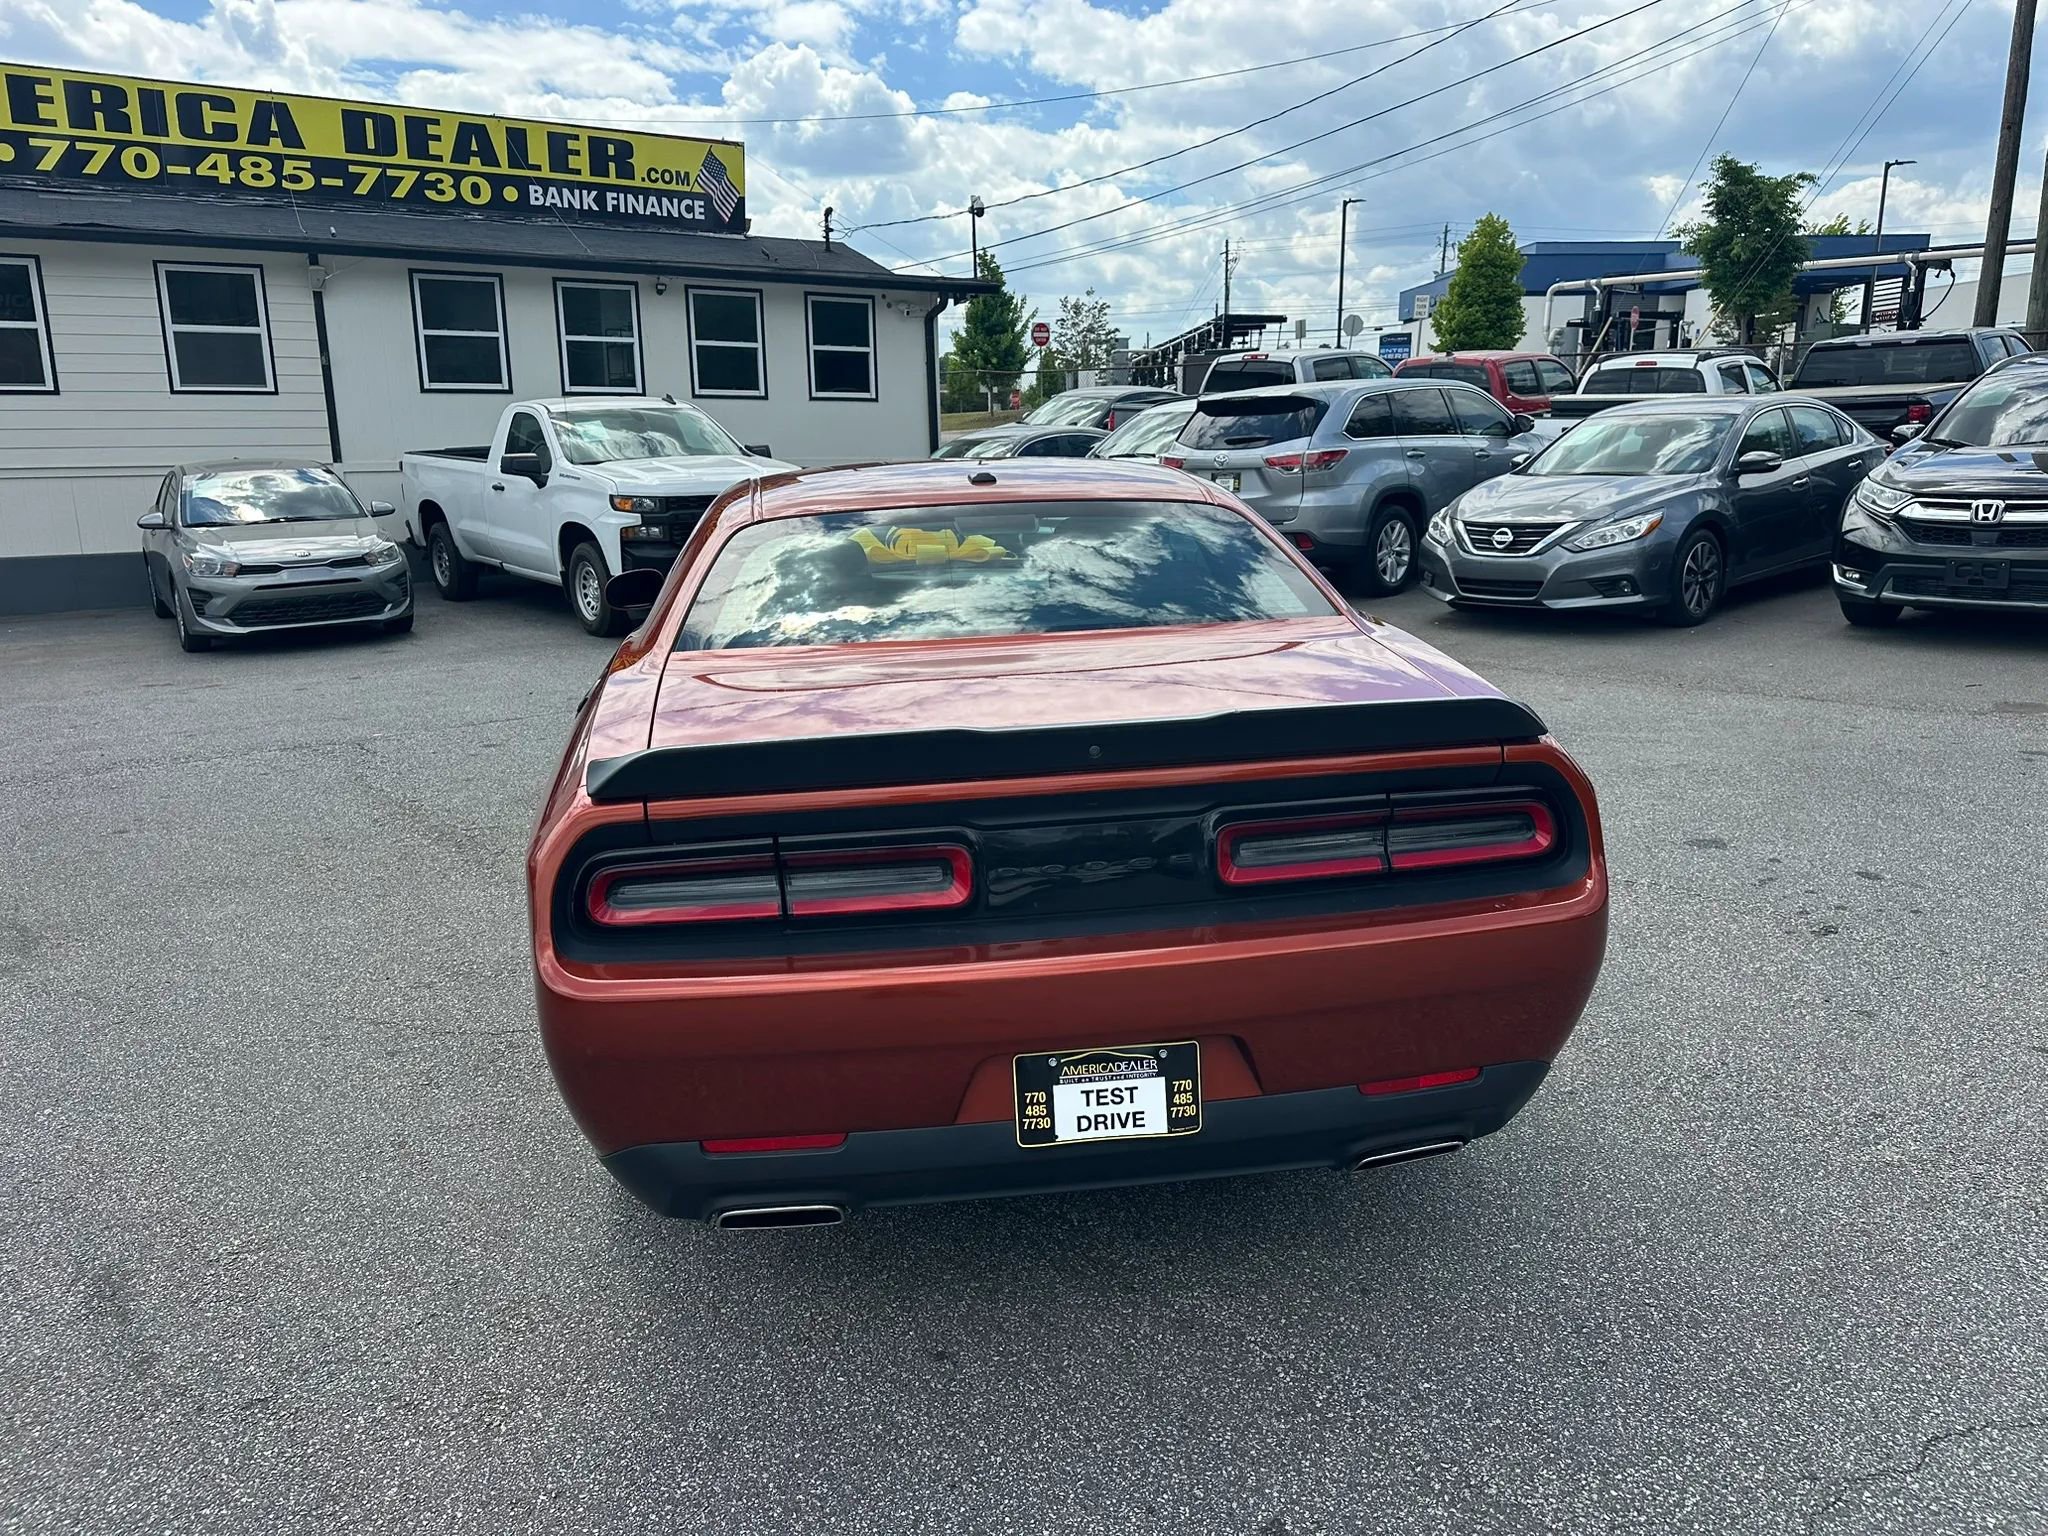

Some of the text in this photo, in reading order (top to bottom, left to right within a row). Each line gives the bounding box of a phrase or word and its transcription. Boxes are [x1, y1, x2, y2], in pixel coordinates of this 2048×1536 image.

[5, 73, 307, 150] ERICA
[28, 137, 493, 206] 770-485-7730
[529, 184, 706, 220] BANK FINANCE
[1059, 1077, 1078, 1085] BUILT
[1172, 1080, 1193, 1092] 770
[1025, 1091, 1047, 1104] 770
[1080, 1086, 1139, 1107] TEST
[1173, 1092, 1193, 1105] 485
[1025, 1104, 1047, 1117] 485
[1170, 1104, 1197, 1118] 7730
[1022, 1117, 1051, 1130] 7730
[1076, 1110, 1146, 1133] DRIVE
